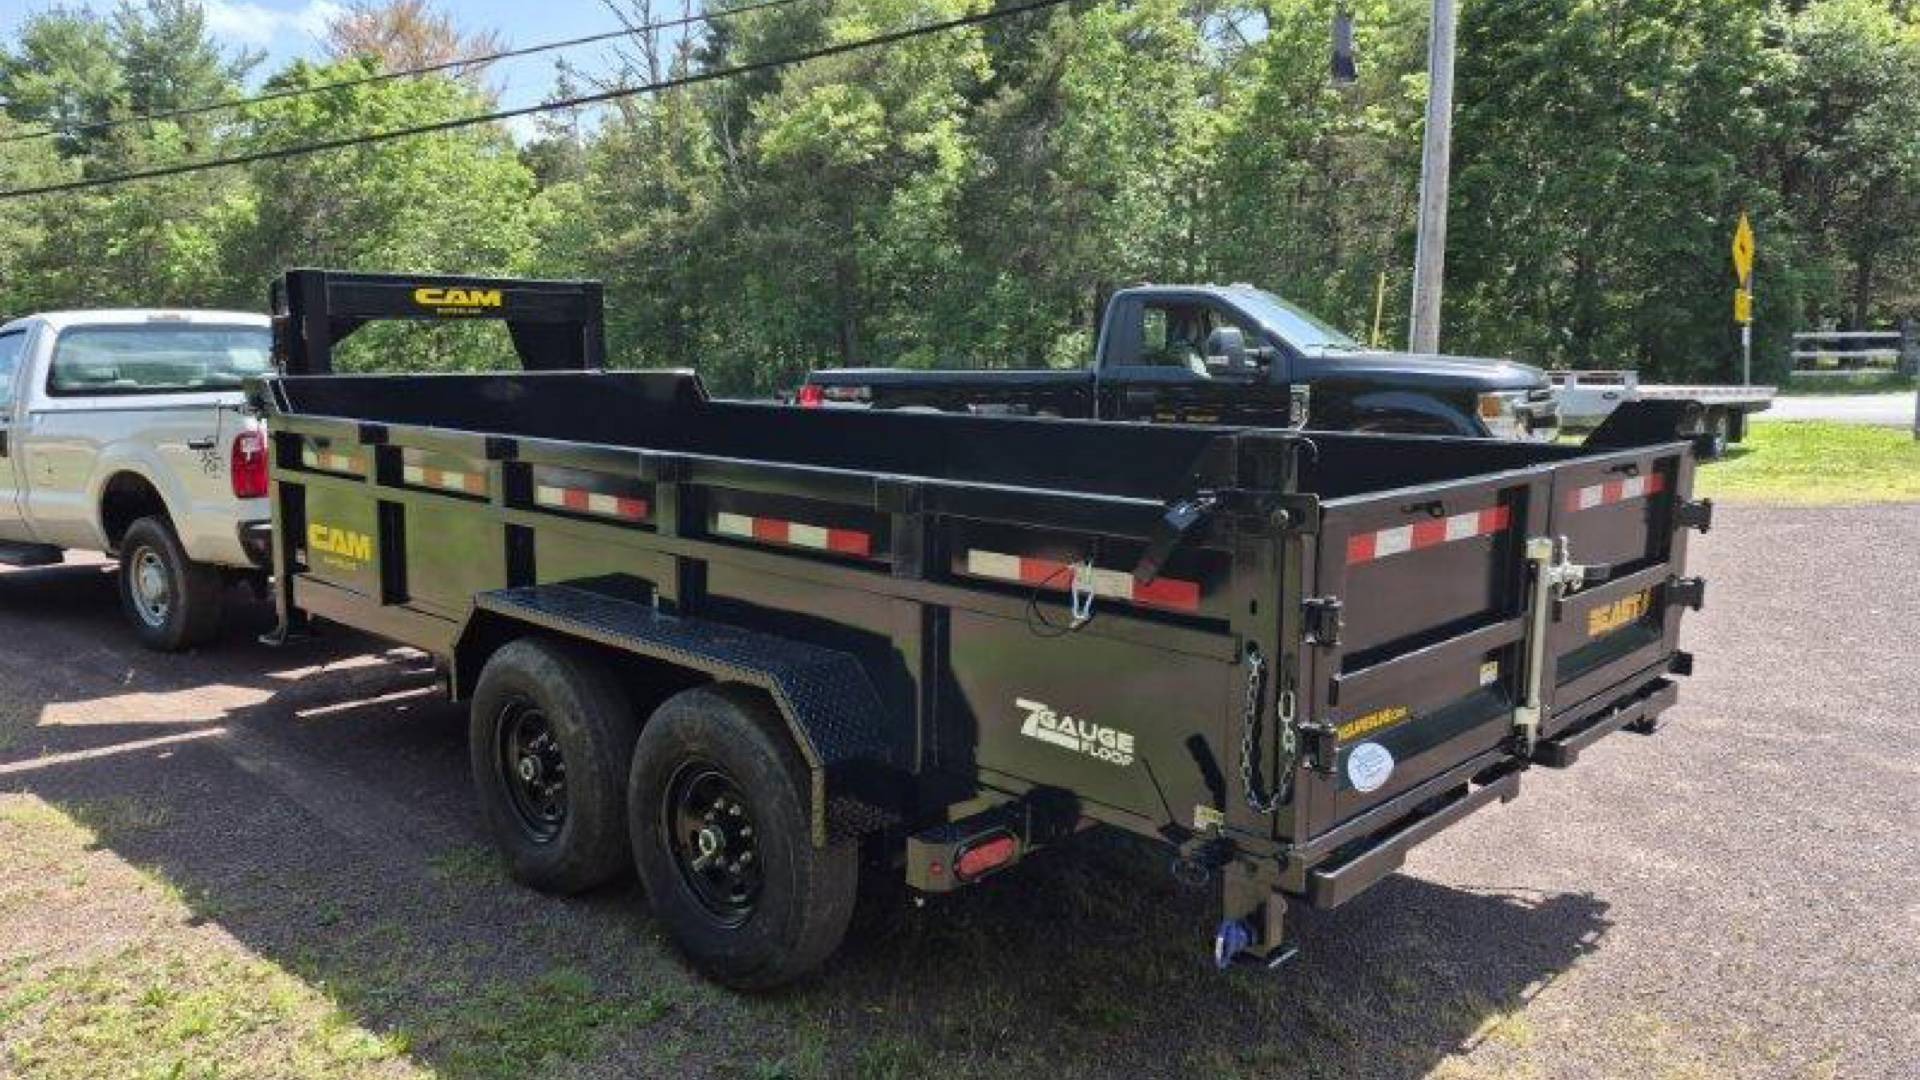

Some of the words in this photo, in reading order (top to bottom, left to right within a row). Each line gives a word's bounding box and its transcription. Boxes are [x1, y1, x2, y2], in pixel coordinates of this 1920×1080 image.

[415, 287, 502, 308] CAM
[307, 522, 372, 562] CAM
[1039, 711, 1135, 755] GAUGE
